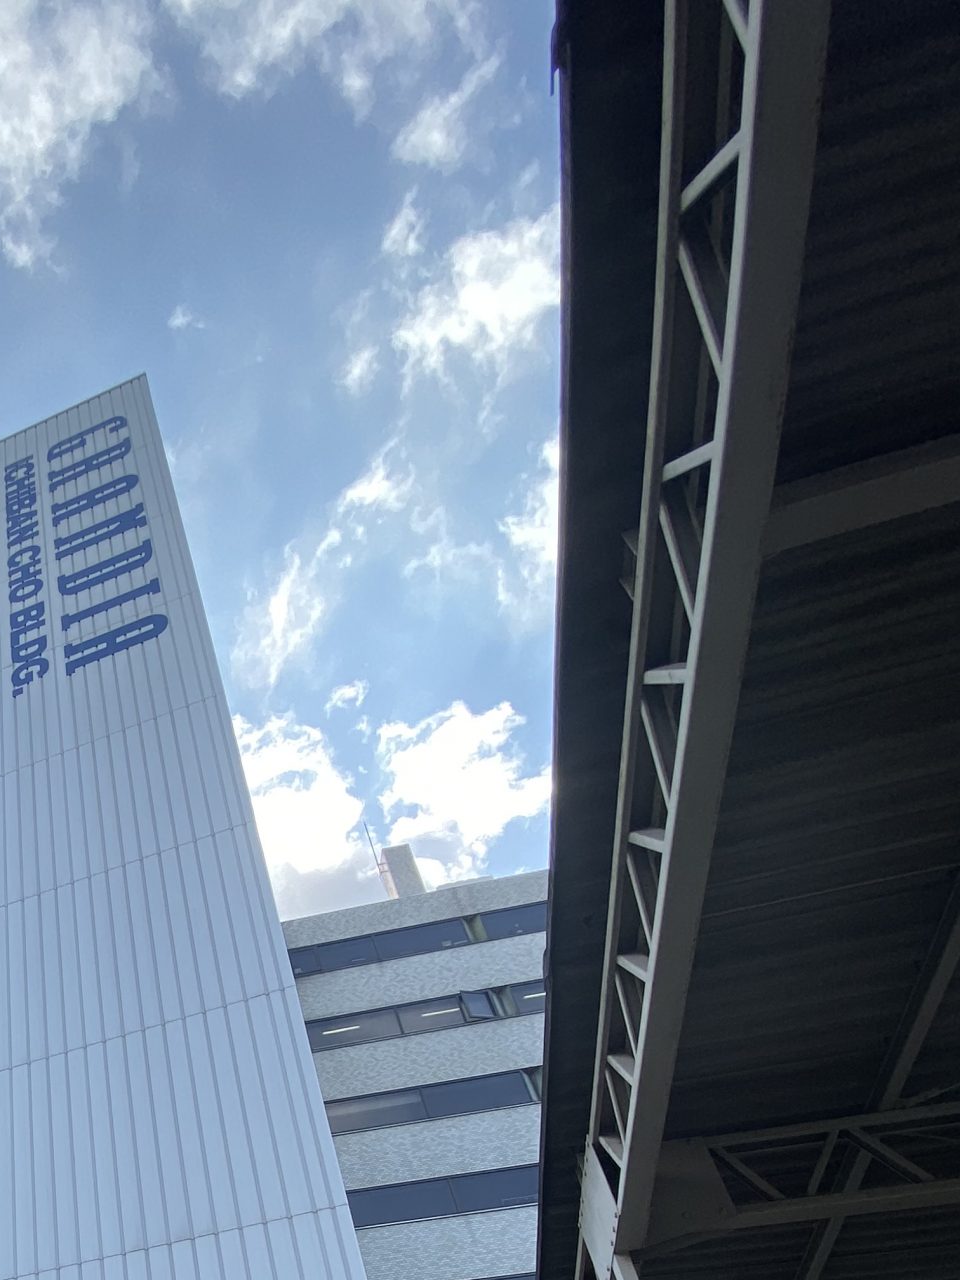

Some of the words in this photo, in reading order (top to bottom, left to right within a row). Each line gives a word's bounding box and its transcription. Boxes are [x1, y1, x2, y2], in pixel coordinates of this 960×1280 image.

[4, 454, 40, 549] ICHIBAN
[47, 416, 168, 676] GRANDIA
[7, 546, 44, 603] CHO
[9, 601, 50, 699] BLDG.
